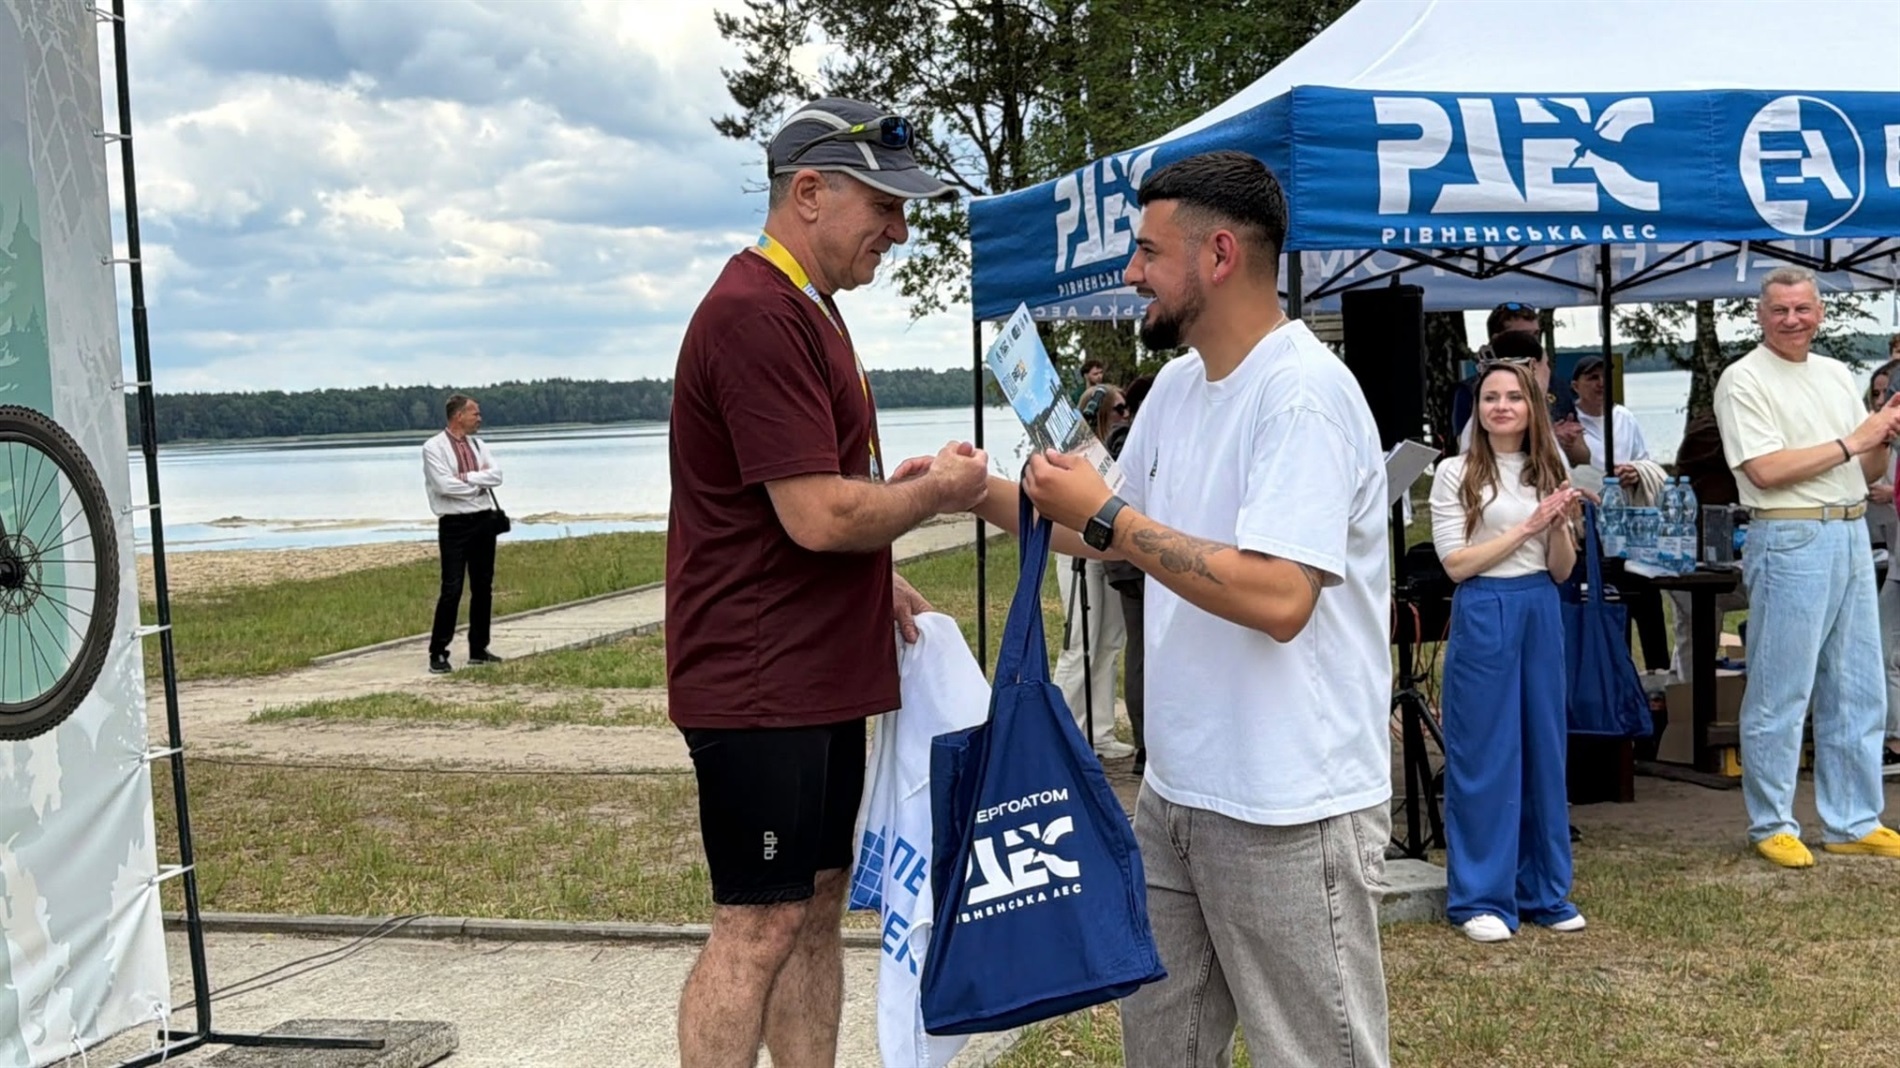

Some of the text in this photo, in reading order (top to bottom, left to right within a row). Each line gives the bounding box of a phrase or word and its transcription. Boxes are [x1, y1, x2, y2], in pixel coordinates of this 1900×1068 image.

[1381, 223, 1658, 245] РІВНЕНСЬКА АЕС
[1057, 267, 1126, 297] РІВНЕНСЬК
[975, 787, 1069, 825] ЕРГОАТОМ
[763, 831, 778, 860] dhb
[1053, 883, 1082, 898] АЕС
